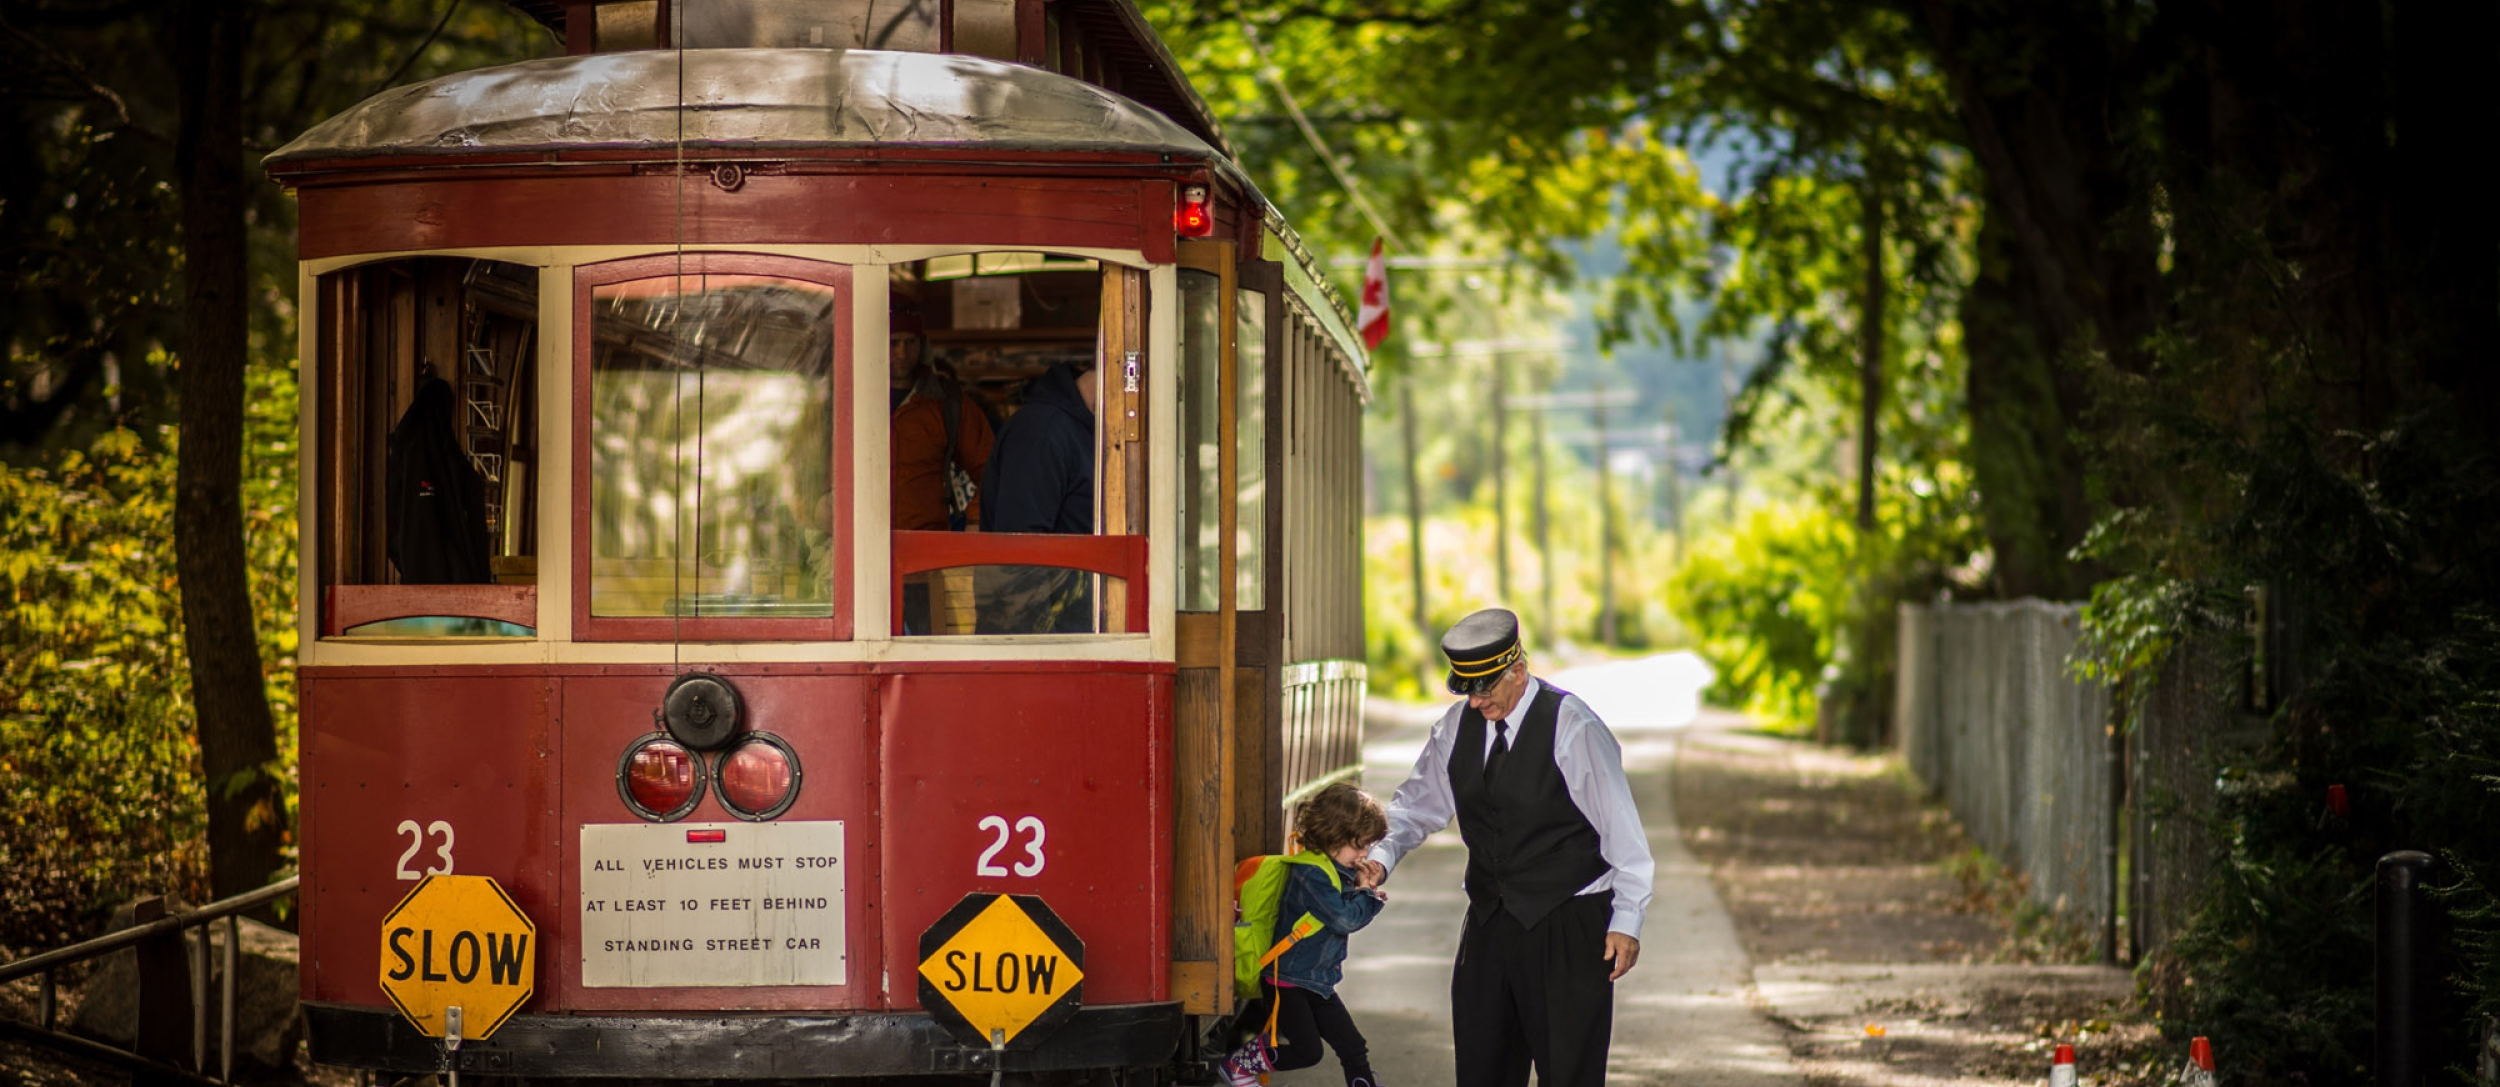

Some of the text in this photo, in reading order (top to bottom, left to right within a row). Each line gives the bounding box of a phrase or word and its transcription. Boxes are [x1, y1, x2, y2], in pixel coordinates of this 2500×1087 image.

[397, 820, 454, 880] 23
[594, 857, 838, 871] ALL VEHICLES MUST STOP
[976, 815, 1046, 877] 23
[586, 898, 828, 911] AT LEAST 10 FEET BEHIND
[387, 926, 528, 986] SLOW
[604, 938, 821, 952] STANDING STREET CAR
[944, 950, 1057, 996] SLOW
